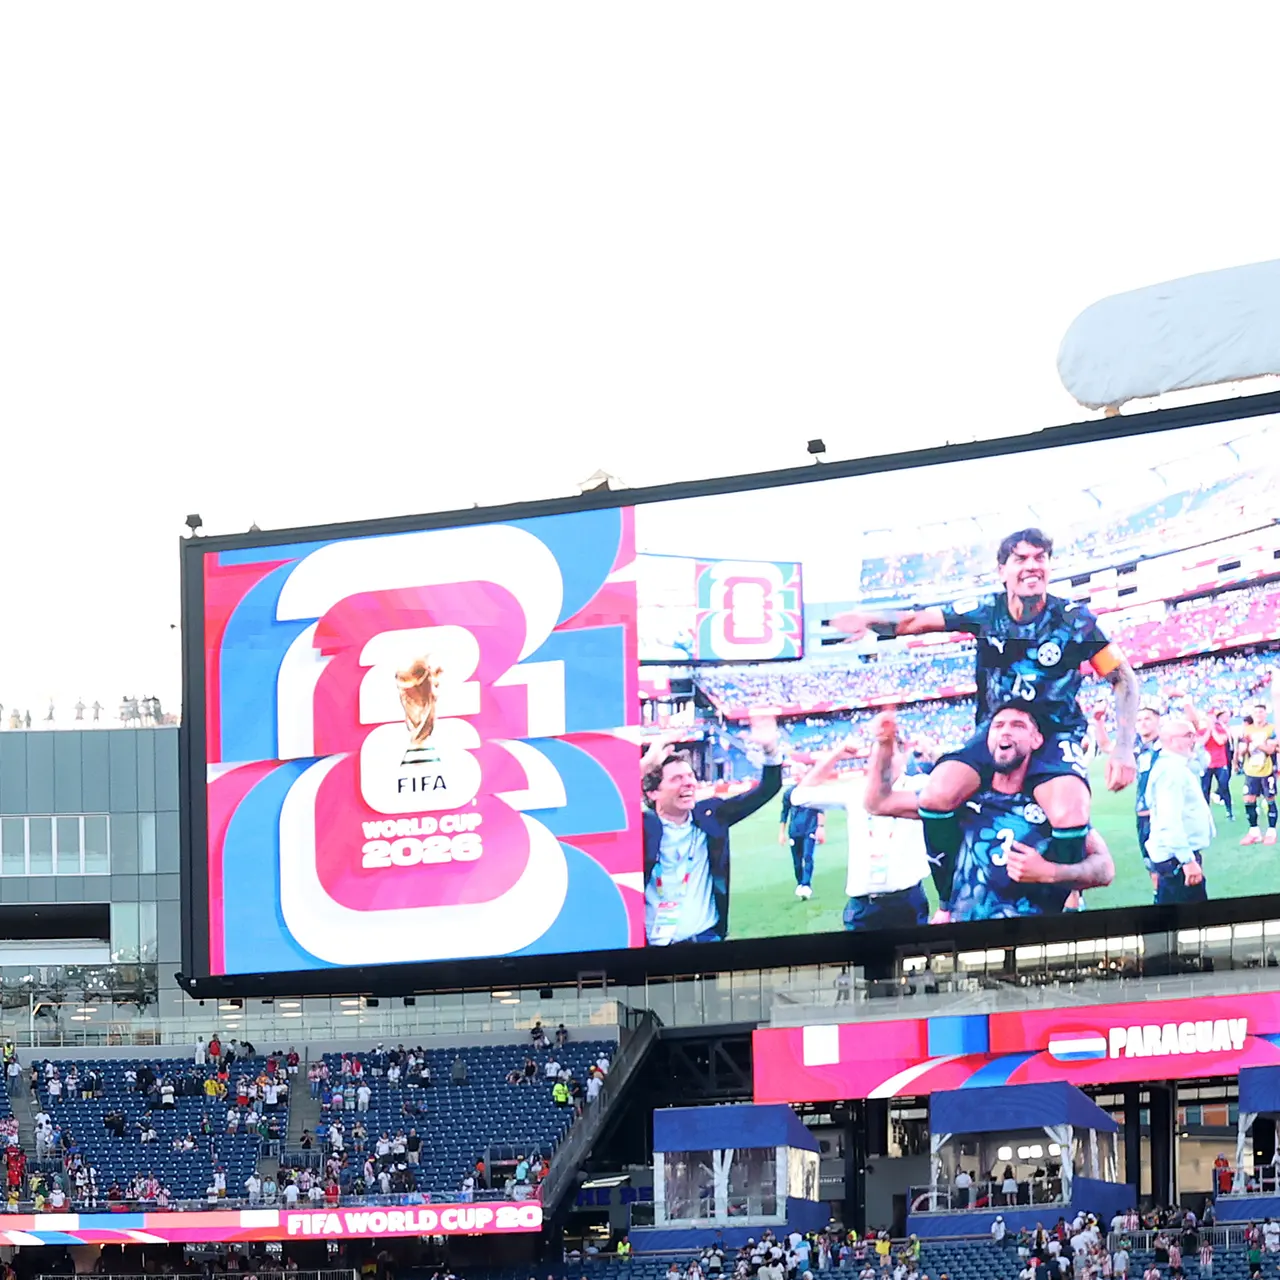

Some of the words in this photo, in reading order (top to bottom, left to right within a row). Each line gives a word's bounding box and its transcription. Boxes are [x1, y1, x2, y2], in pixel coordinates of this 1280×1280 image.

[397, 775, 447, 793] FIFA
[361, 816, 438, 839] WORLD
[439, 812, 483, 833] CUP
[361, 832, 484, 868] 2026
[1108, 1018, 1248, 1059] PARAGUAY
[287, 1213, 342, 1235] FIFA
[344, 1210, 438, 1234] WORLD
[440, 1207, 493, 1231] CUP
